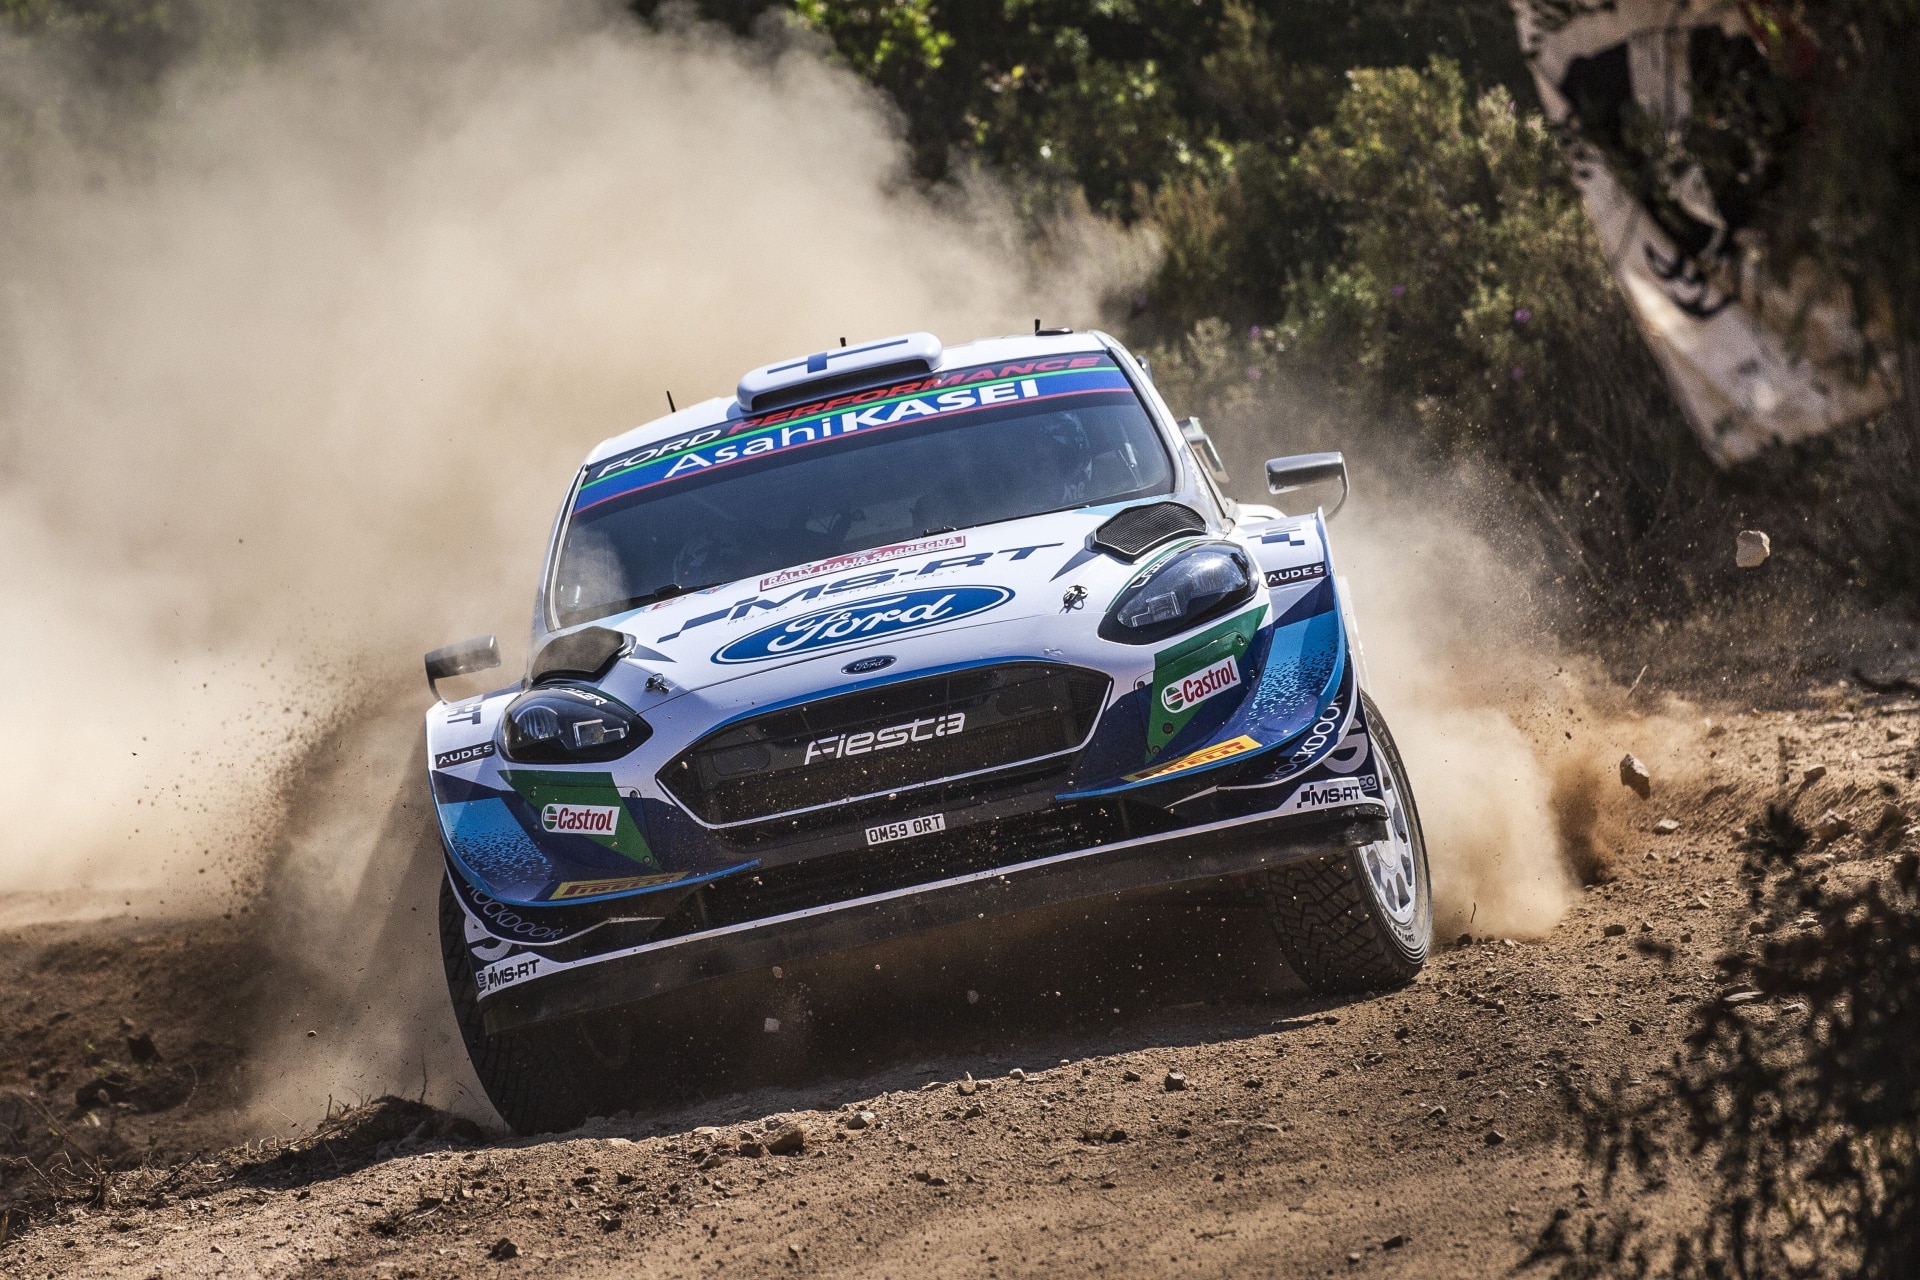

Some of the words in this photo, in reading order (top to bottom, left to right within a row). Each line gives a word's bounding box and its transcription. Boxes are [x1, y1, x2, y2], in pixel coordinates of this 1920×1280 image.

[596, 429, 722, 478] FORD
[727, 357, 1100, 435] PERFORMANCE
[768, 566, 818, 586] RALLY
[818, 555, 869, 574] ITALIA
[871, 537, 957, 561] SARDEGNA
[1267, 565, 1324, 583] AUDES
[767, 594, 957, 652] Ford
[853, 658, 885, 671] Ford
[1183, 660, 1237, 703] Castrol
[438, 744, 493, 765] AUDES
[804, 712, 966, 765] Fiesta
[558, 807, 613, 831] Castrol
[868, 823, 908, 843] OM59
[913, 815, 942, 834] ORT
